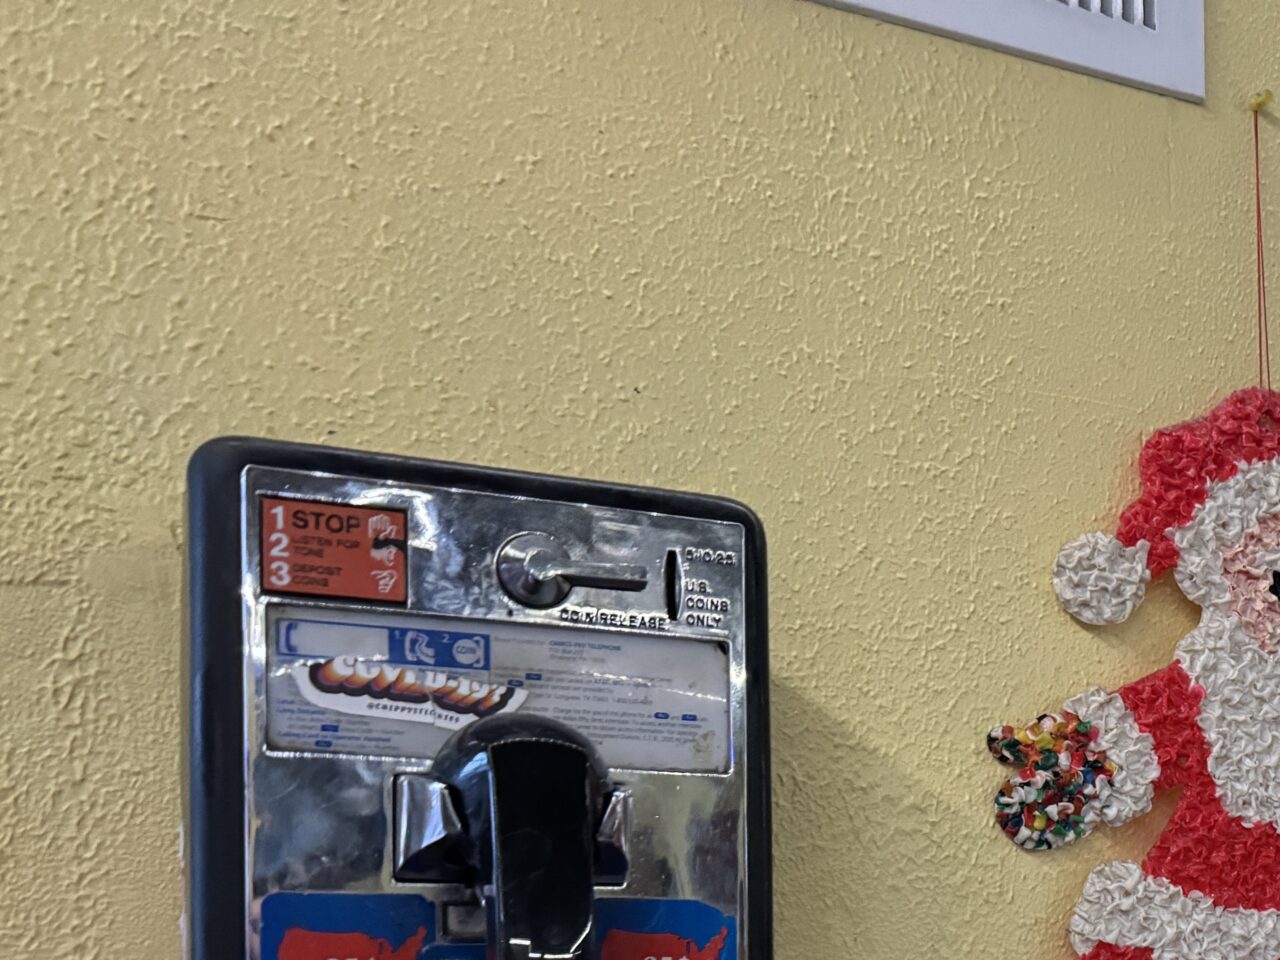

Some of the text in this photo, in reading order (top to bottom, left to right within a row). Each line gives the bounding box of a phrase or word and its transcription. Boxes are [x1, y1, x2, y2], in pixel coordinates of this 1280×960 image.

[271, 505, 361, 533] 1 STOP
[269, 532, 361, 557] 2 LISTEN FOR
[293, 546, 324, 558] TONE
[269, 560, 342, 586] 3 DEPOSIT
[292, 575, 329, 588] COINS
[686, 597, 730, 613] COINS
[560, 607, 667, 631] COIN RELEASE
[686, 613, 723, 628] ONLY
